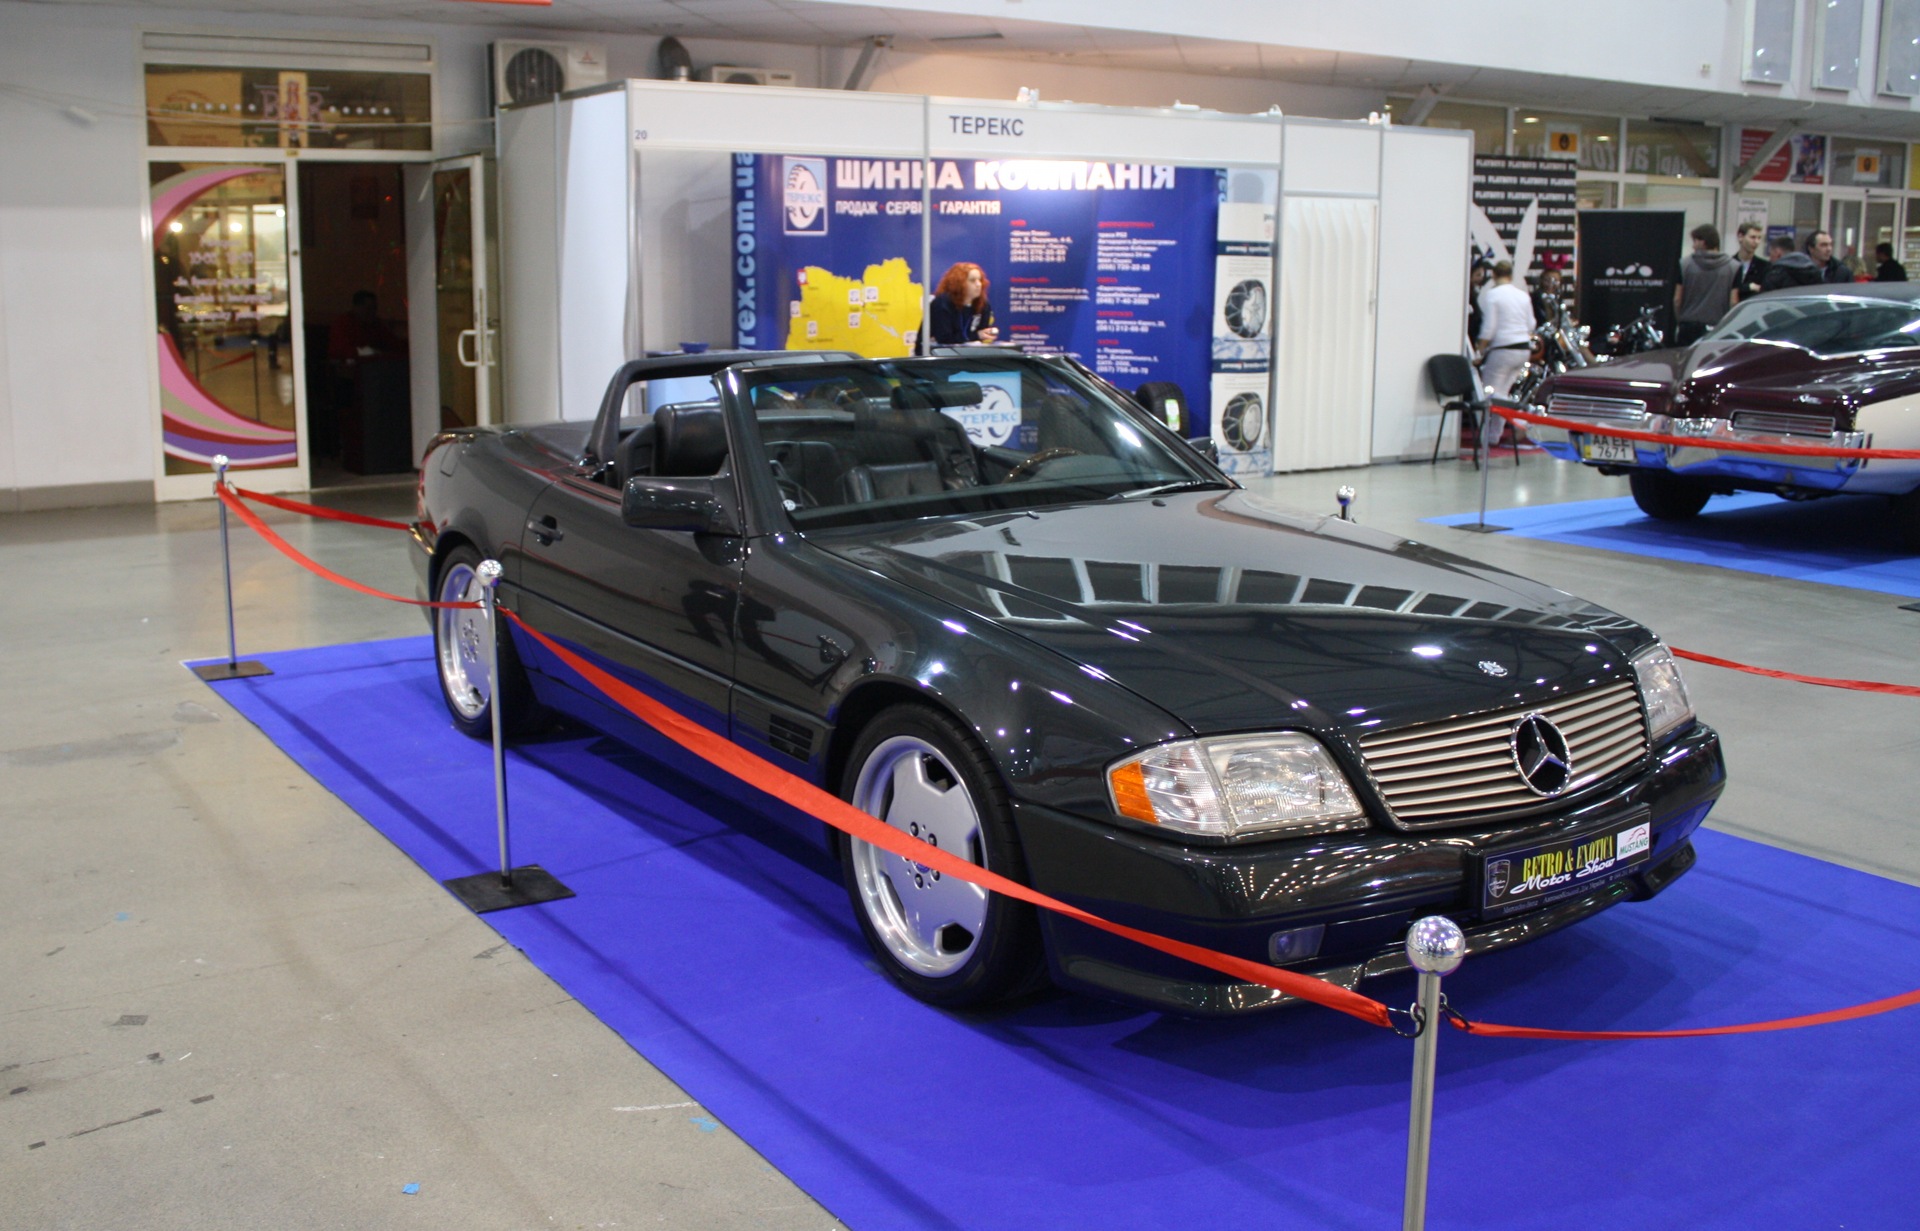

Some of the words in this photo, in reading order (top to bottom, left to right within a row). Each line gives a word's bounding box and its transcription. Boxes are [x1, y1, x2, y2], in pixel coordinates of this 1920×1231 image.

[635, 129, 648, 140] 20
[949, 115, 1024, 136] ТЕРЕКС
[836, 160, 963, 189] ШИННА
[974, 160, 1176, 190] КОМПАНІЯ
[835, 200, 878, 215] ПРОДАЖ
[885, 201, 923, 215] СЕРВІ
[940, 201, 1001, 215] ГАРАНТІЯ
[737, 152, 756, 350] rex.com.ua
[961, 411, 1018, 424] ТЕРЕКС
[1598, 446, 1626, 458] 7671
[1619, 836, 1649, 855] MUSTANG
[1510, 873, 1571, 894] Motor
[1576, 857, 1615, 877] Show
[1523, 851, 1562, 882] RETRO
